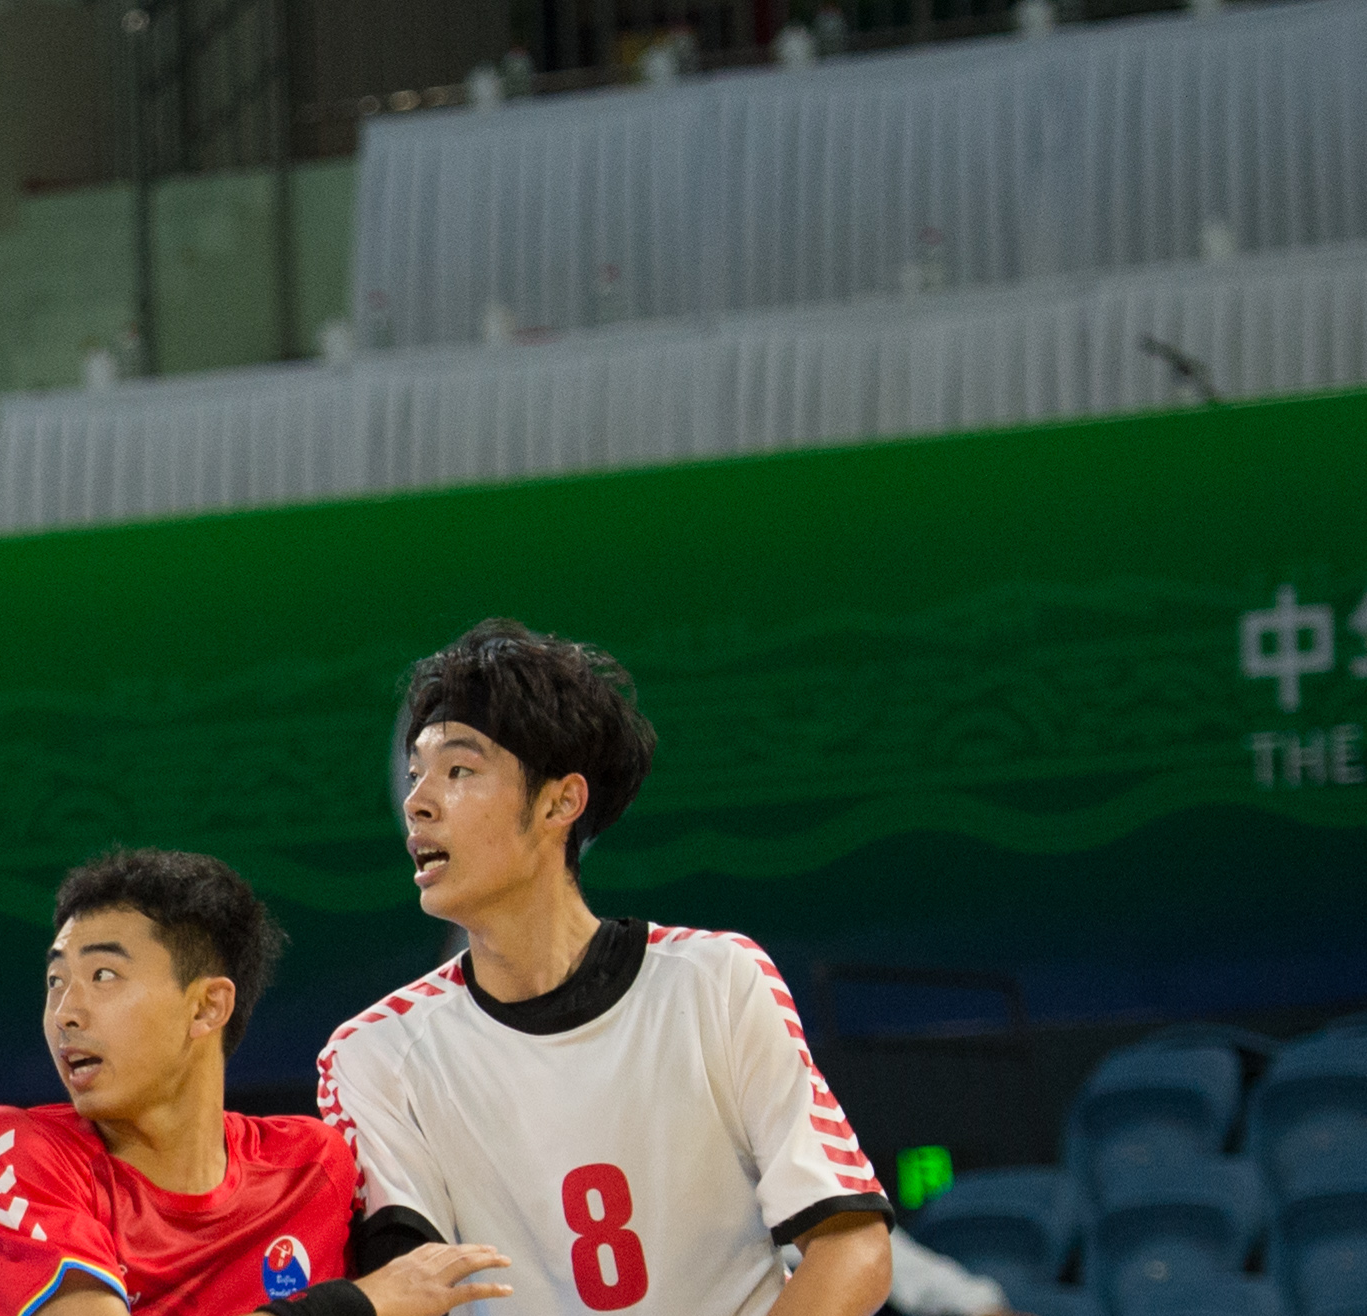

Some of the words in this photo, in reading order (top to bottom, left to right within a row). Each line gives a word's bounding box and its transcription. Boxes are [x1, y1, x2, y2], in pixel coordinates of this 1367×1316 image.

[1239, 582, 1367, 713] 中
[1249, 723, 1366, 788] THE
[561, 1163, 649, 1311] 8
